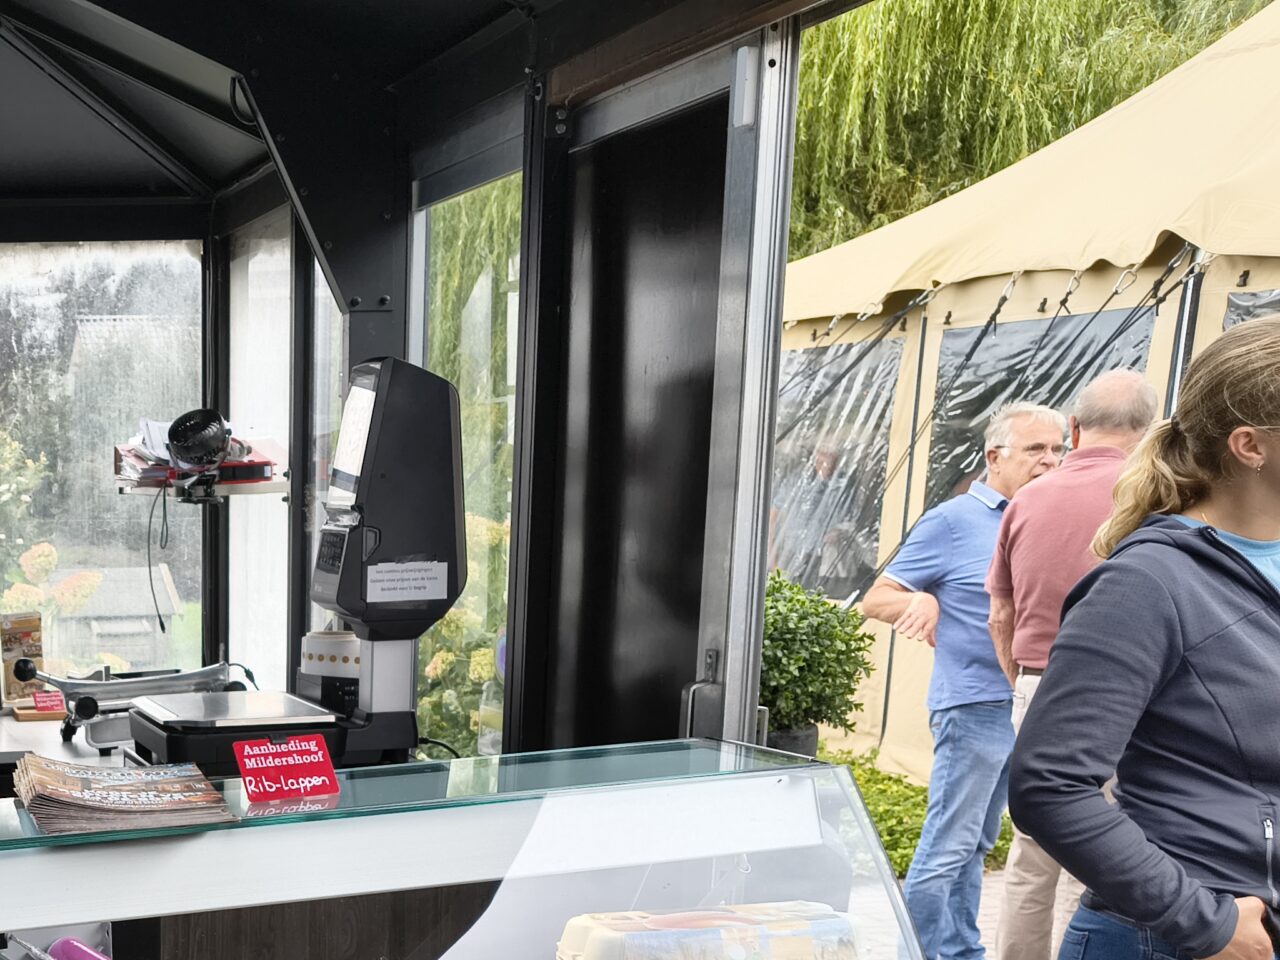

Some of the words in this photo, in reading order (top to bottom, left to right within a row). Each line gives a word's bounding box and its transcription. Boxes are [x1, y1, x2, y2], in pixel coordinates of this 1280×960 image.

[243, 740, 319, 756] Aanbieding
[243, 751, 324, 769] Mildershoof
[245, 775, 330, 795] Rib-lappen
